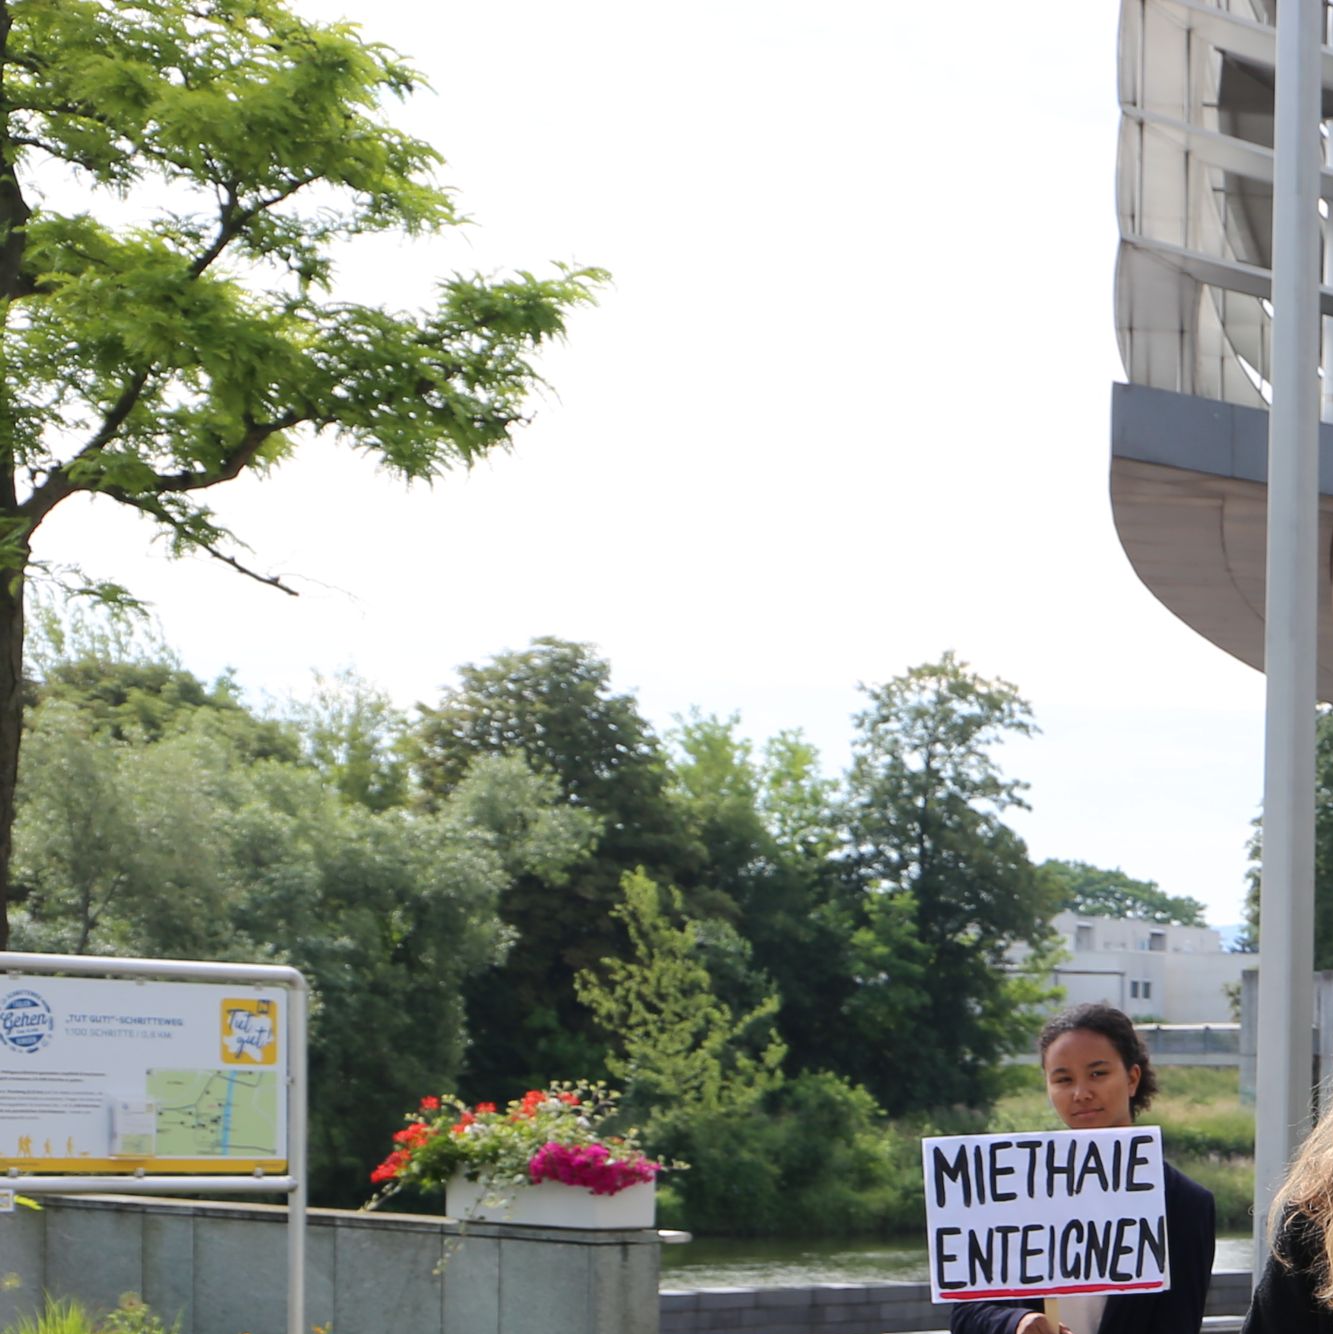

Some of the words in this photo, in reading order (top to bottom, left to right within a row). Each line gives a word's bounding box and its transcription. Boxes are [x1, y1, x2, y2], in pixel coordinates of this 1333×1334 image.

[1, 1011, 47, 1036] Gehen
[932, 1135, 1155, 1209] MIETHAIE
[935, 1215, 1167, 1290] ENTEIGNEN
